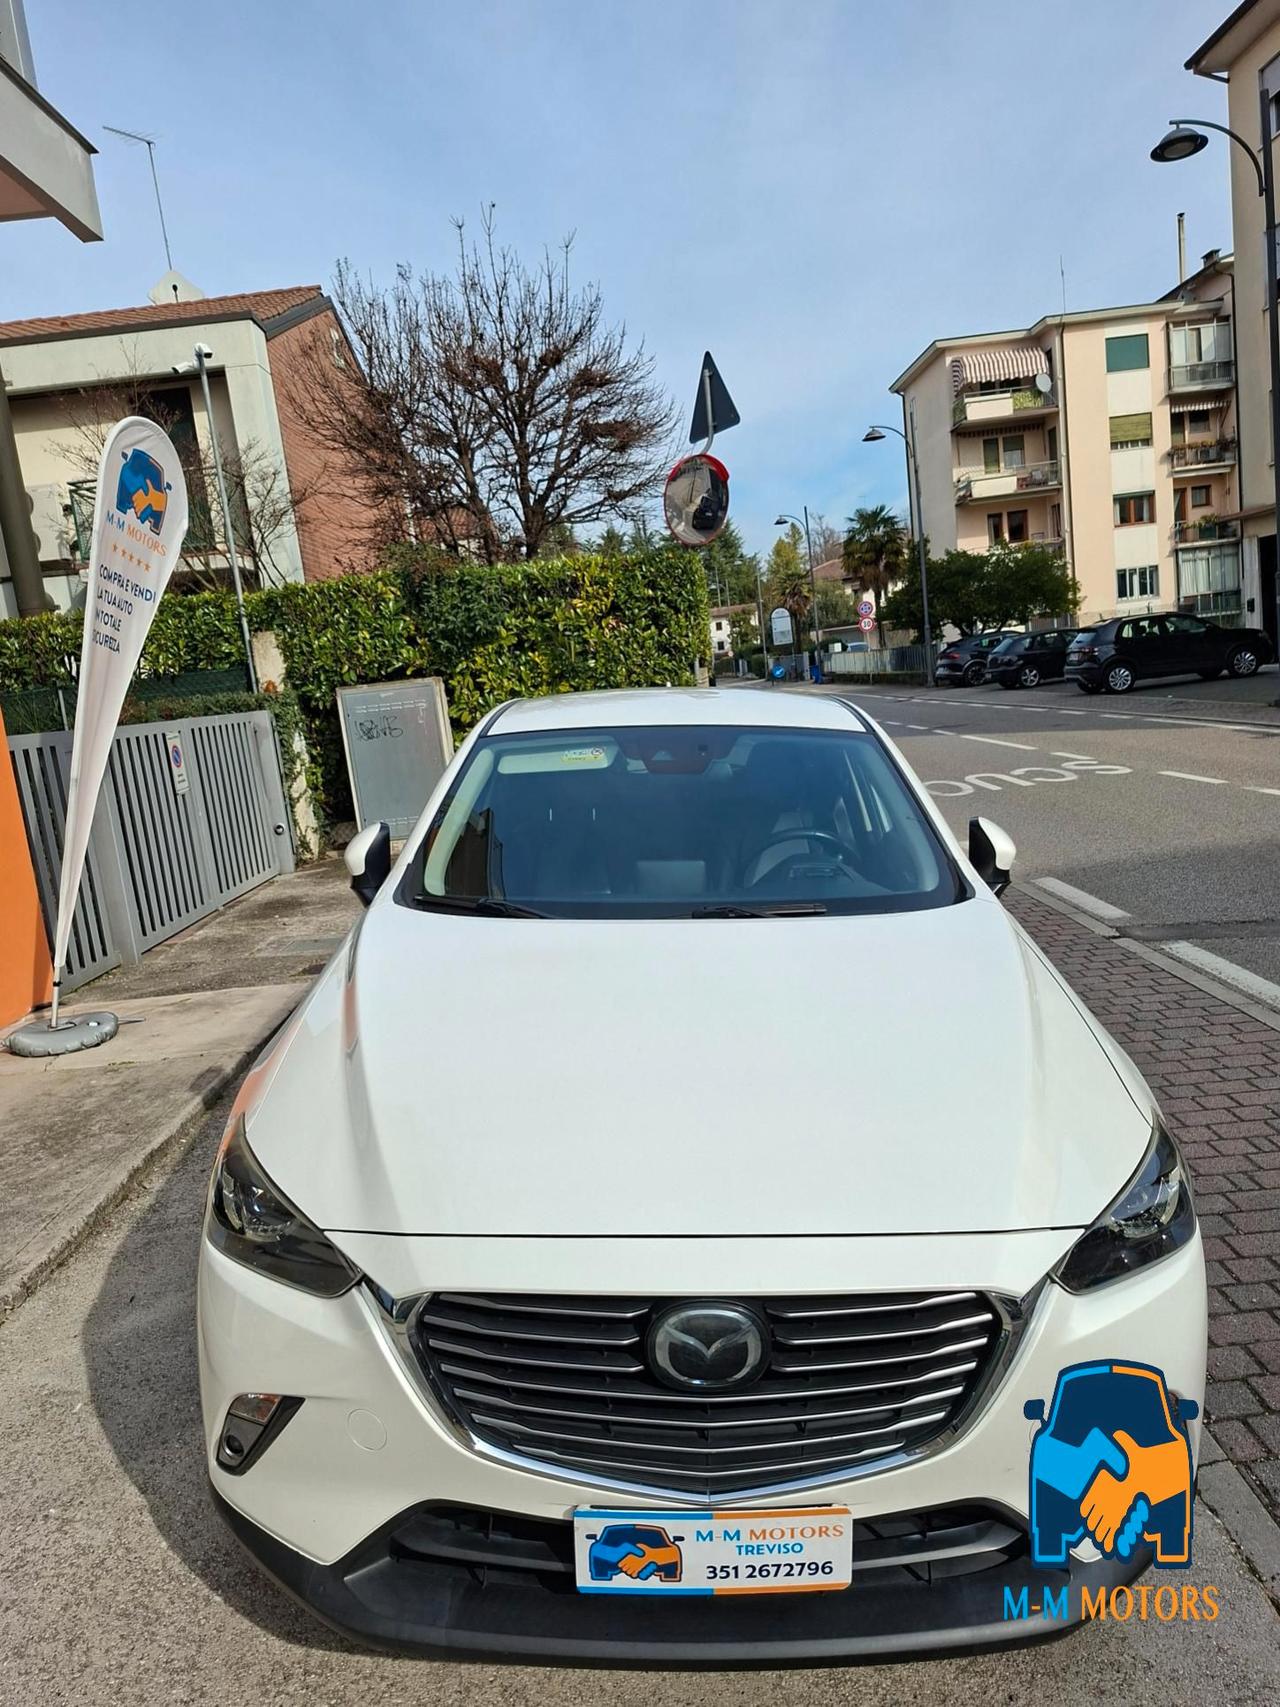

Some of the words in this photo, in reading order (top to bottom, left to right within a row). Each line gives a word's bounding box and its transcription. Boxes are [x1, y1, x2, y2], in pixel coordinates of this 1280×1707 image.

[106, 510, 125, 532] M-M
[127, 524, 168, 557] MOTORS
[99, 564, 124, 590] COMPRA
[124, 579, 130, 592] E
[130, 581, 157, 603] VENDI
[103, 589, 118, 608] TUA
[924, 760, 1134, 797] SCUO
[695, 1528, 741, 1542] M-M
[749, 1524, 844, 1542] MOTORS
[736, 1543, 804, 1557] TREVISO
[706, 1565, 740, 1580] 351
[745, 1561, 834, 1579] 2672796
